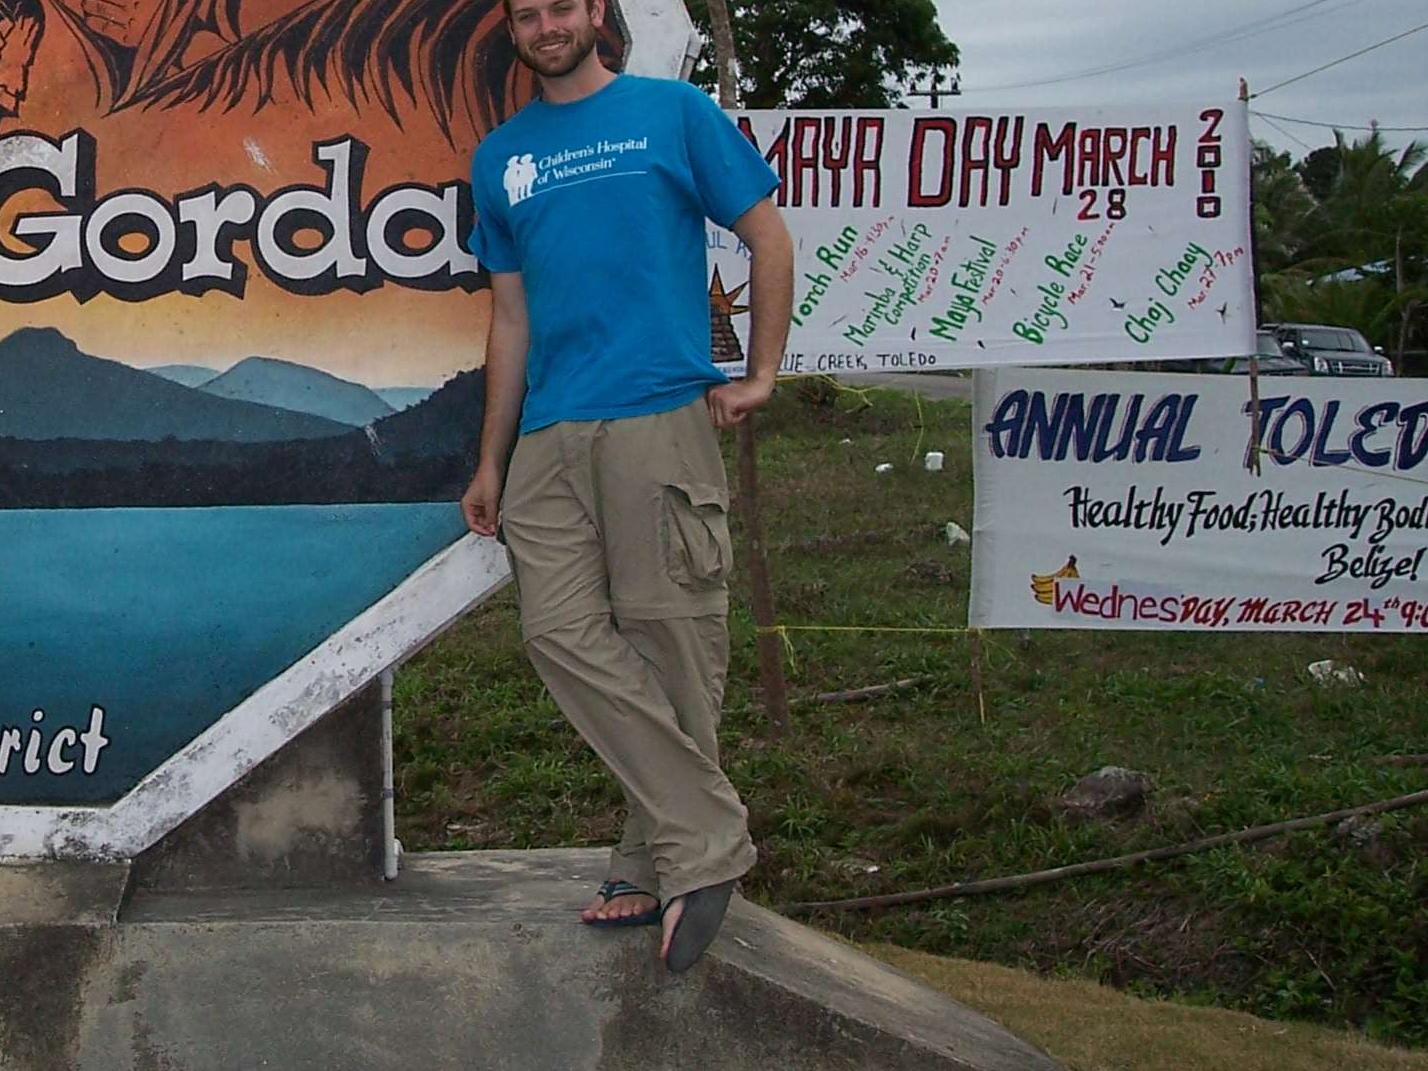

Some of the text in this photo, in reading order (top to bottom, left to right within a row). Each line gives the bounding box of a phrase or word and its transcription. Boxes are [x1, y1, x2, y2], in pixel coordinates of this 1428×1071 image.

[537, 157, 613, 185] of Wisconsin
[538, 136, 647, 170] Children's Hospital
[907, 115, 1024, 208] DAY
[1031, 122, 1177, 197] MARCH
[1196, 109, 1223, 218] 2010
[1077, 189, 1126, 220] 28
[815, 225, 859, 271] Run
[842, 287, 896, 347] Marimba
[887, 223, 932, 264] Harp
[884, 253, 931, 325] Competition
[929, 235, 997, 342] Maya Festival
[1012, 233, 1088, 344] Bicycle Race
[1124, 297, 1175, 343] Chaj
[817, 354, 867, 370] CREEK,
[876, 352, 937, 366] TOLEDO
[984, 389, 1202, 464] ANNUAL
[1063, 485, 1185, 546] Healthy
[1259, 489, 1371, 539] Healthy
[1368, 496, 1428, 544] Bod
[1314, 543, 1428, 589] Belize!
